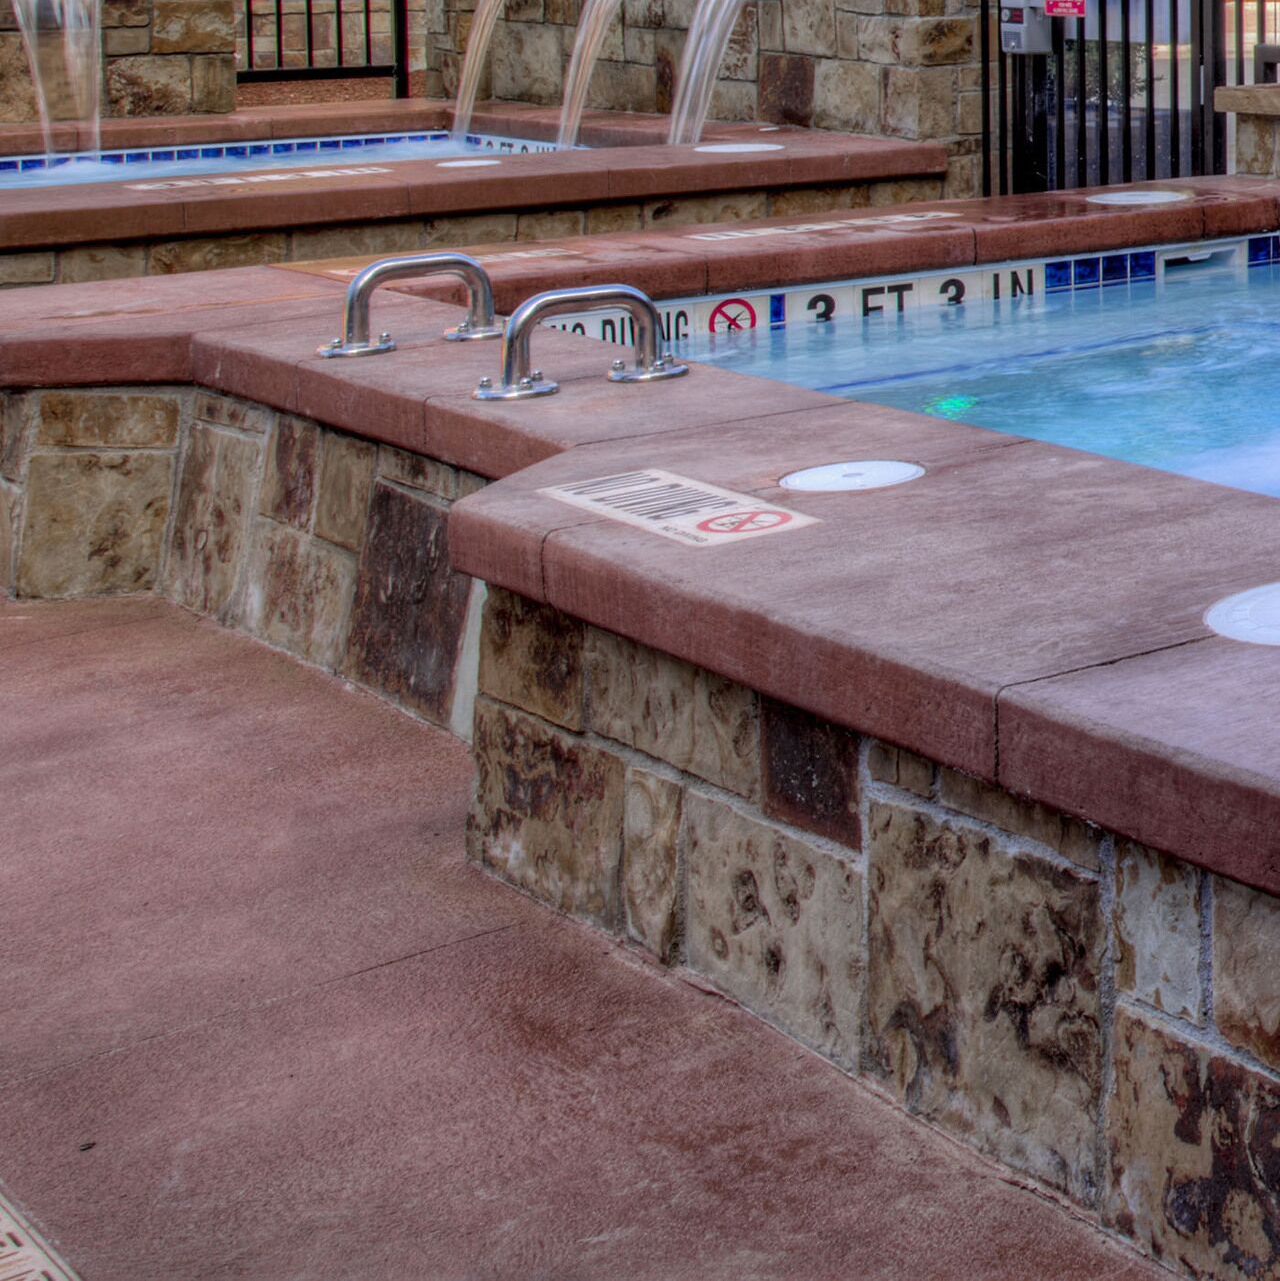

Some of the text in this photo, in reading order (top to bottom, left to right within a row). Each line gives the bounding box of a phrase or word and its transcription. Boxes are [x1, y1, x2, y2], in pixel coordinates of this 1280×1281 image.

[806, 268, 1035, 322] 3 FT 3 IN
[556, 471, 739, 521] NO DIVING
